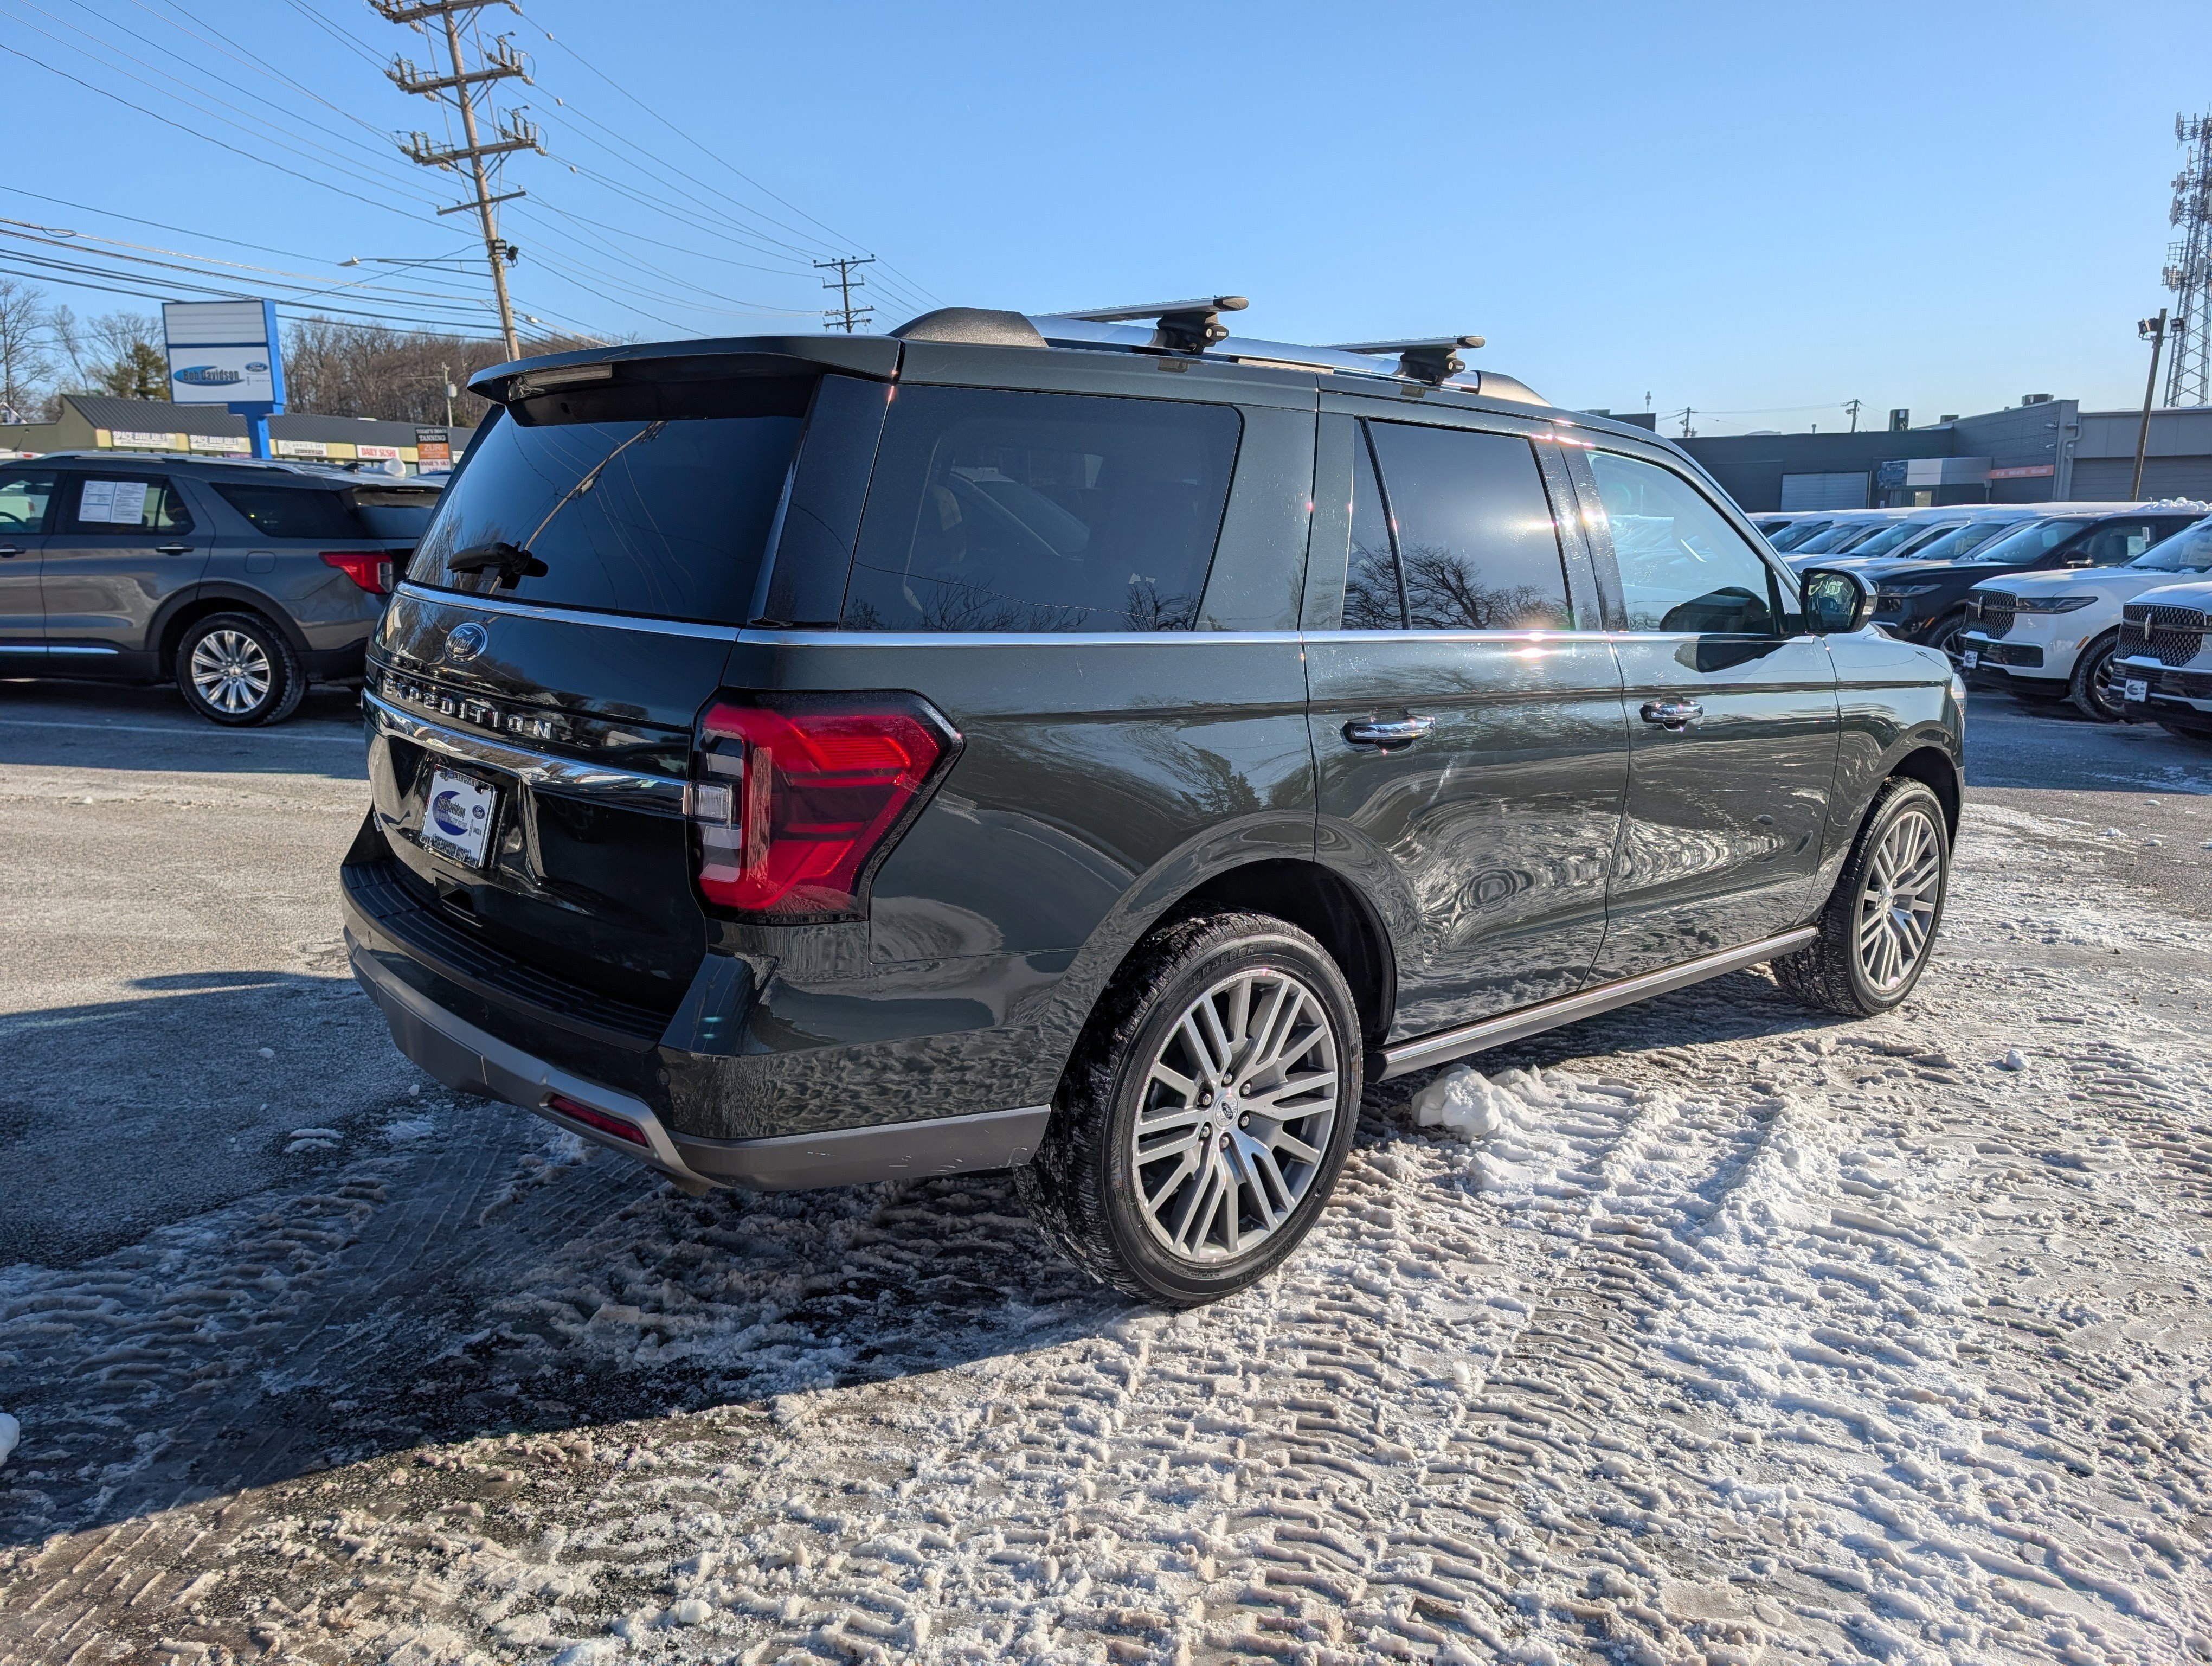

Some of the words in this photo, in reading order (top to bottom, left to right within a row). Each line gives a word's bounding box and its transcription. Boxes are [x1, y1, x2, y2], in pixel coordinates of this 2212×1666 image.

[183, 369, 198, 380] Bob
[201, 369, 239, 381] Davidson
[112, 431, 132, 440] SPACE
[134, 432, 167, 442] AVAILABLE
[190, 435, 208, 443] SPACE
[209, 436, 238, 445] AVAILABLE
[384, 678, 552, 739] EXPEDITION
[446, 799, 466, 818] Davidson
[1193, 946, 1255, 984] GRABBER
[1235, 1239, 1292, 1285] GENERAL
